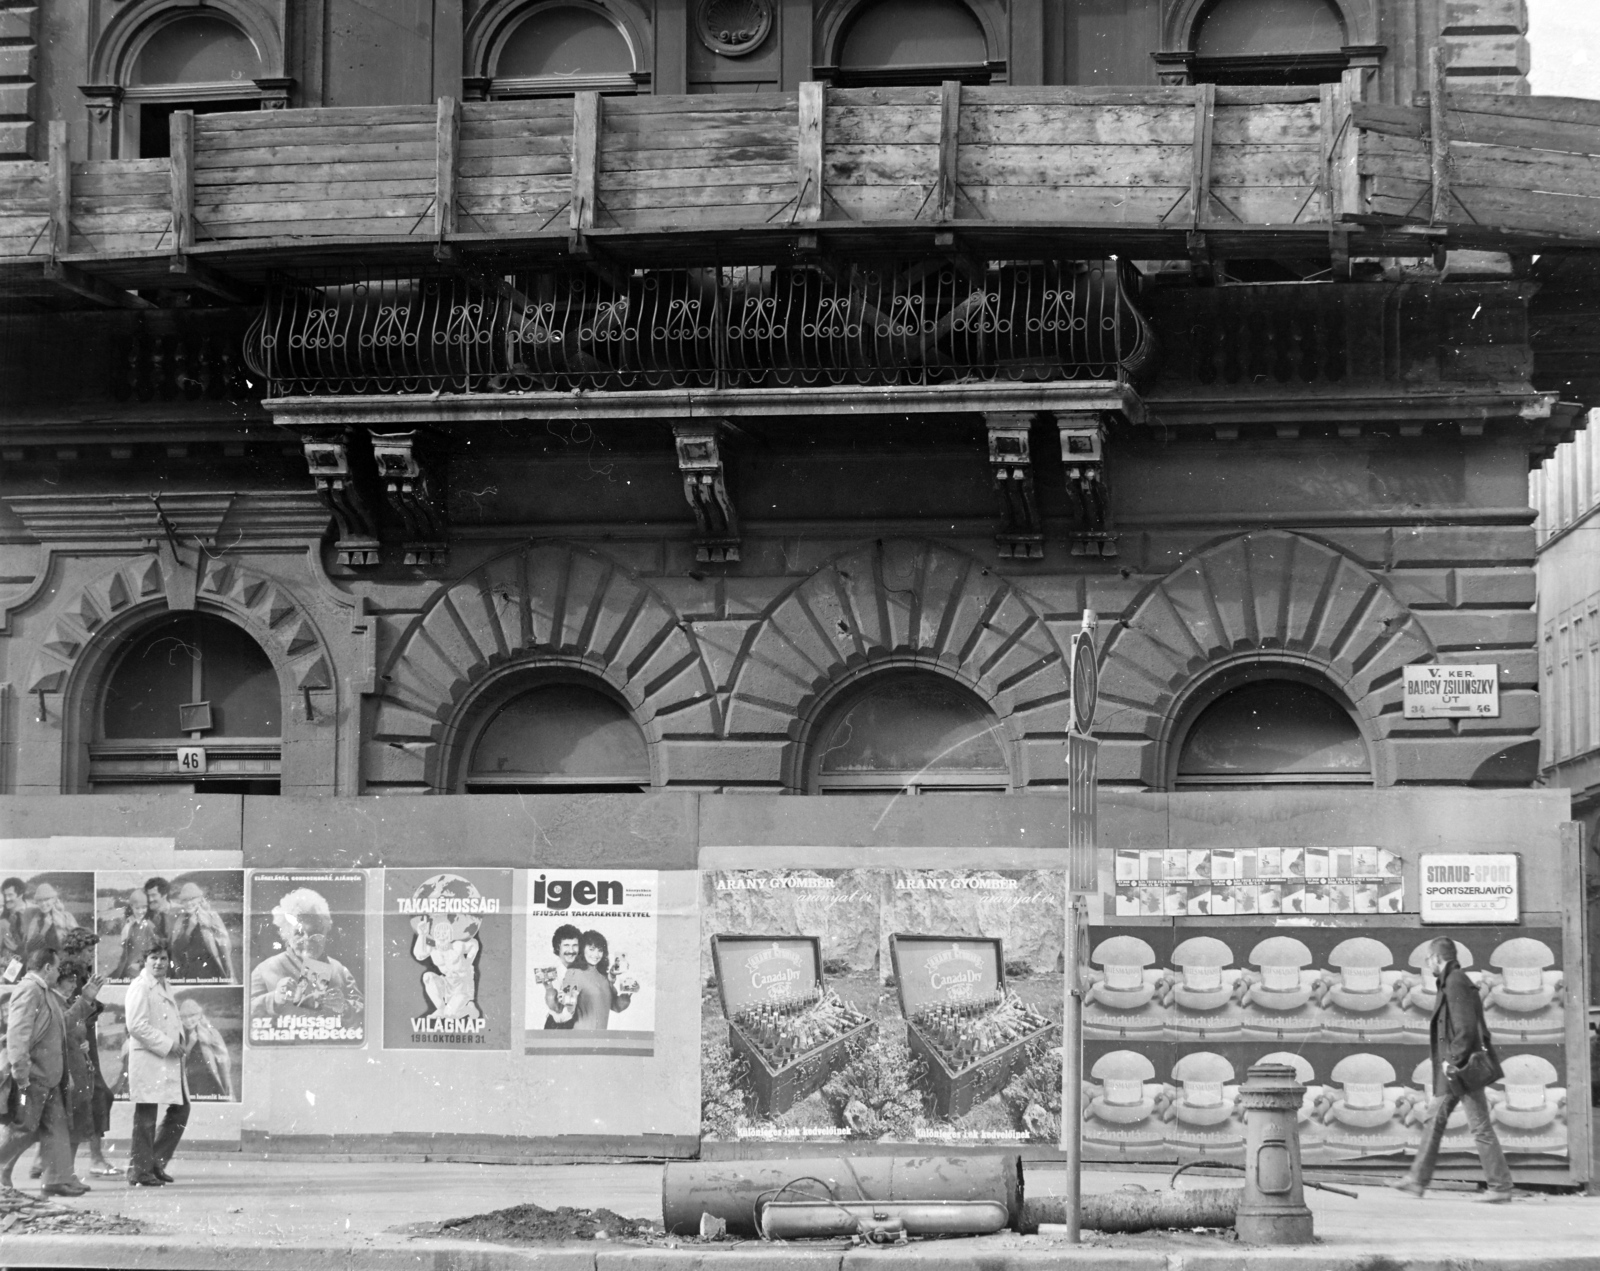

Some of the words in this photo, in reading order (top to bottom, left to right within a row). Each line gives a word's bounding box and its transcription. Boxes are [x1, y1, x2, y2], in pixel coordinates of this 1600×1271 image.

[1427, 668, 1441, 678] V.
[1448, 670, 1475, 678] KER.
[1408, 680, 1441, 695] BAJCSY
[1443, 679, 1494, 695] ZSILINSZKY
[1476, 704, 1491, 713] 46
[182, 752, 199, 769] 46
[1427, 865, 1511, 883] STRAUB-SPORT
[716, 878, 767, 890] ARANY
[895, 878, 948, 890] ARANY
[533, 874, 623, 910] igen
[397, 896, 500, 913] TAKARÉKOSSÁGI
[752, 971, 787, 988] Canada
[787, 968, 800, 981] Dry
[931, 971, 967, 989] Canada
[967, 969, 982, 982] Dry
[252, 1017, 273, 1028] az
[276, 1015, 342, 1029] ifjúsági
[410, 1016, 486, 1033] VILÁGNAP
[1086, 1013, 1160, 1025] kirándulásra
[1165, 1015, 1238, 1027] kirándulásra
[1243, 1015, 1317, 1027] kirándulásra
[1323, 1016, 1399, 1028] kirándulásra
[251, 1026, 363, 1040] takarékbetét
[1086, 1129, 1159, 1140] kirándulásra
[1165, 1130, 1242, 1142] kirándulásra
